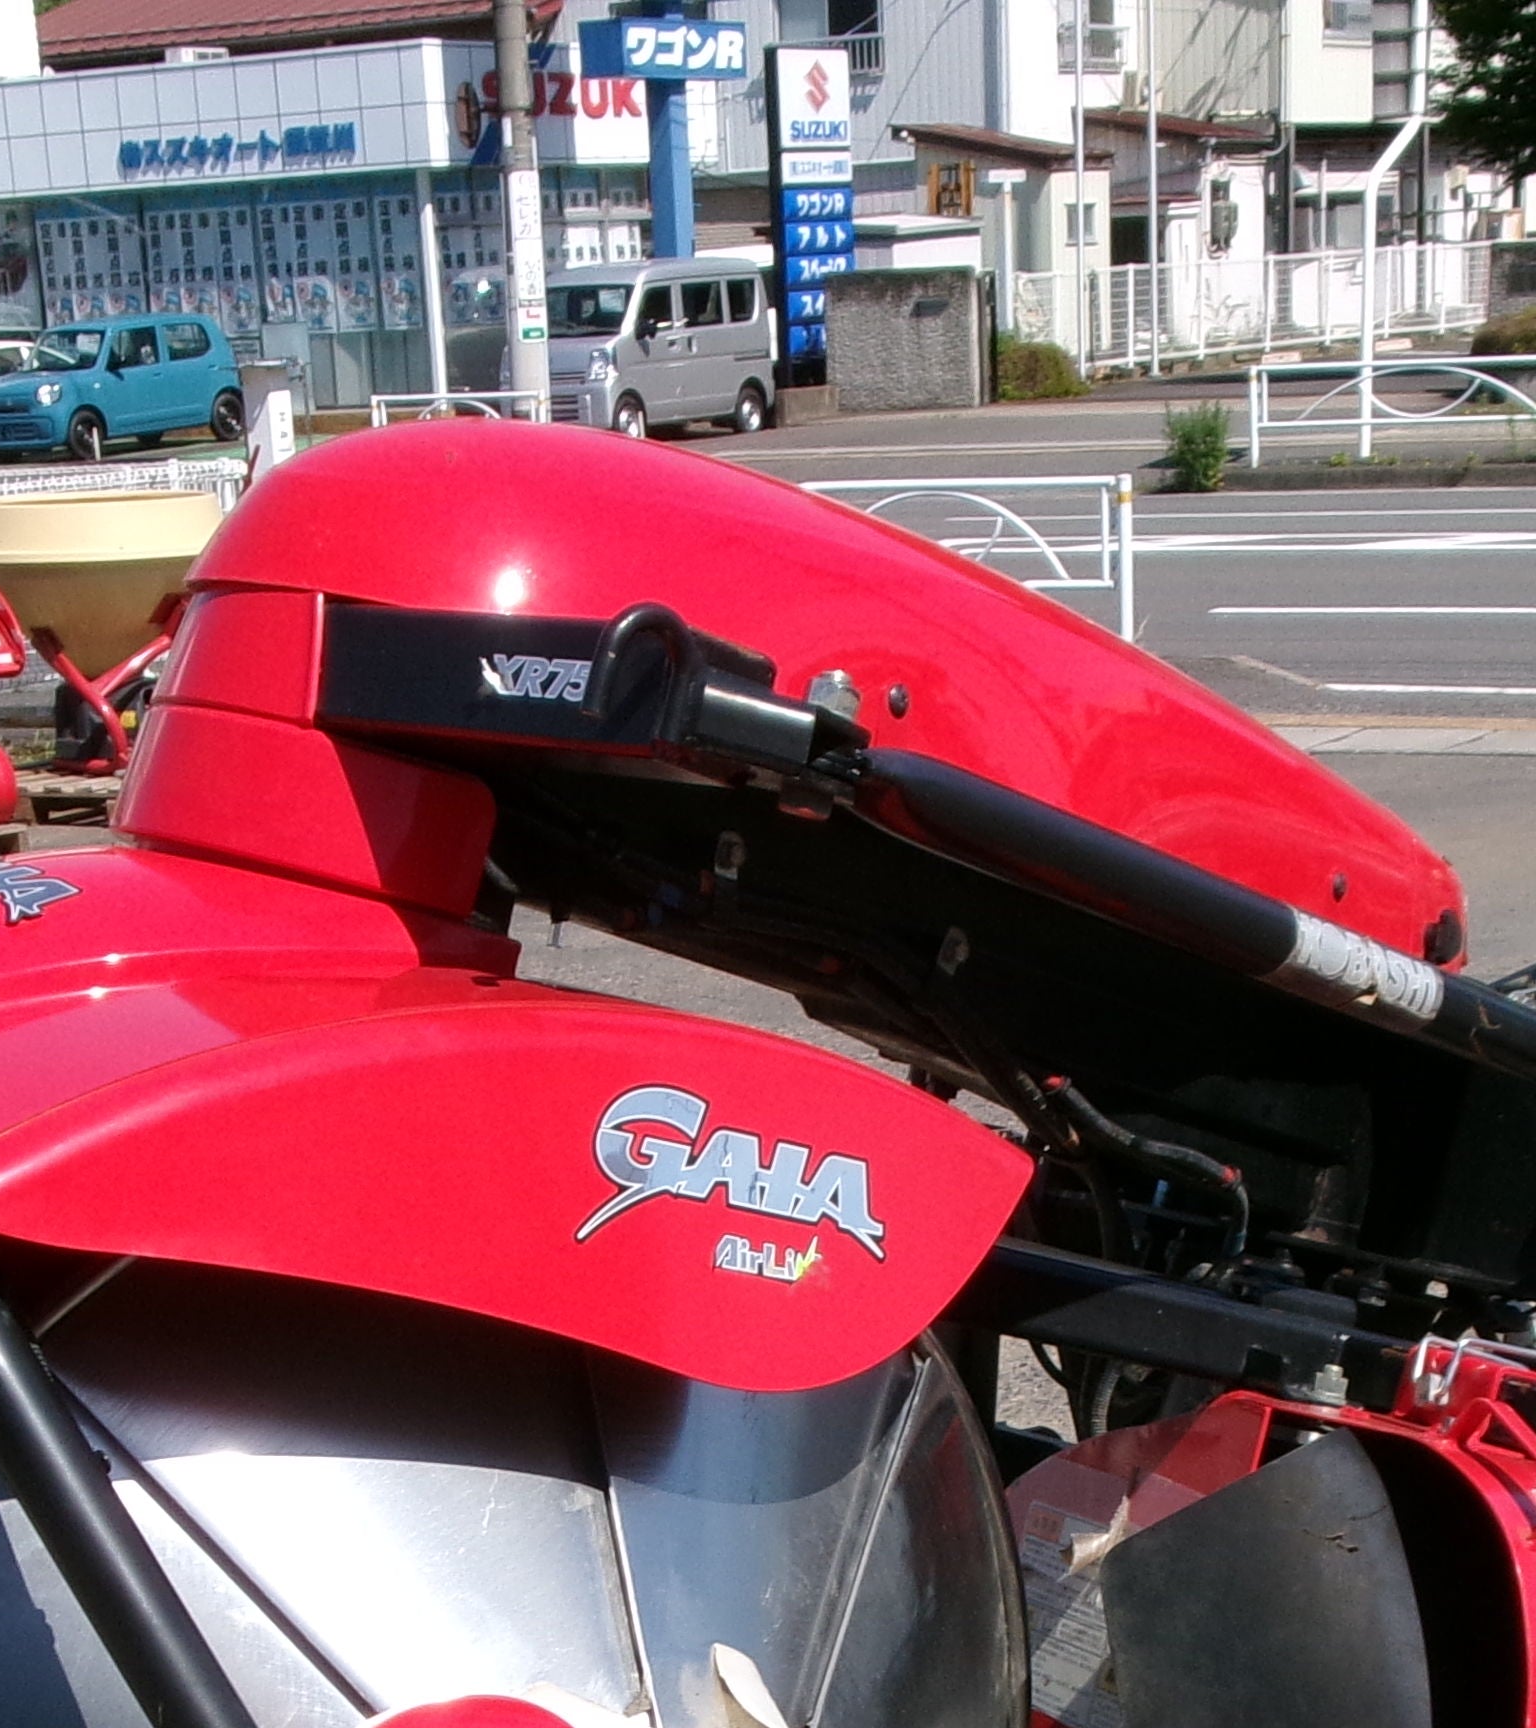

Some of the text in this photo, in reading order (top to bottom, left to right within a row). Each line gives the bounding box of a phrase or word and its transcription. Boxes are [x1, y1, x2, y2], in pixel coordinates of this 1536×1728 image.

[626, 26, 744, 70] ワゴンR
[790, 120, 848, 140] SUZUKI
[796, 193, 845, 217] ワゴンR
[798, 224, 846, 249] アルト
[1297, 912, 1439, 1020] KOBASHI
[575, 1084, 885, 1259] GAIA
